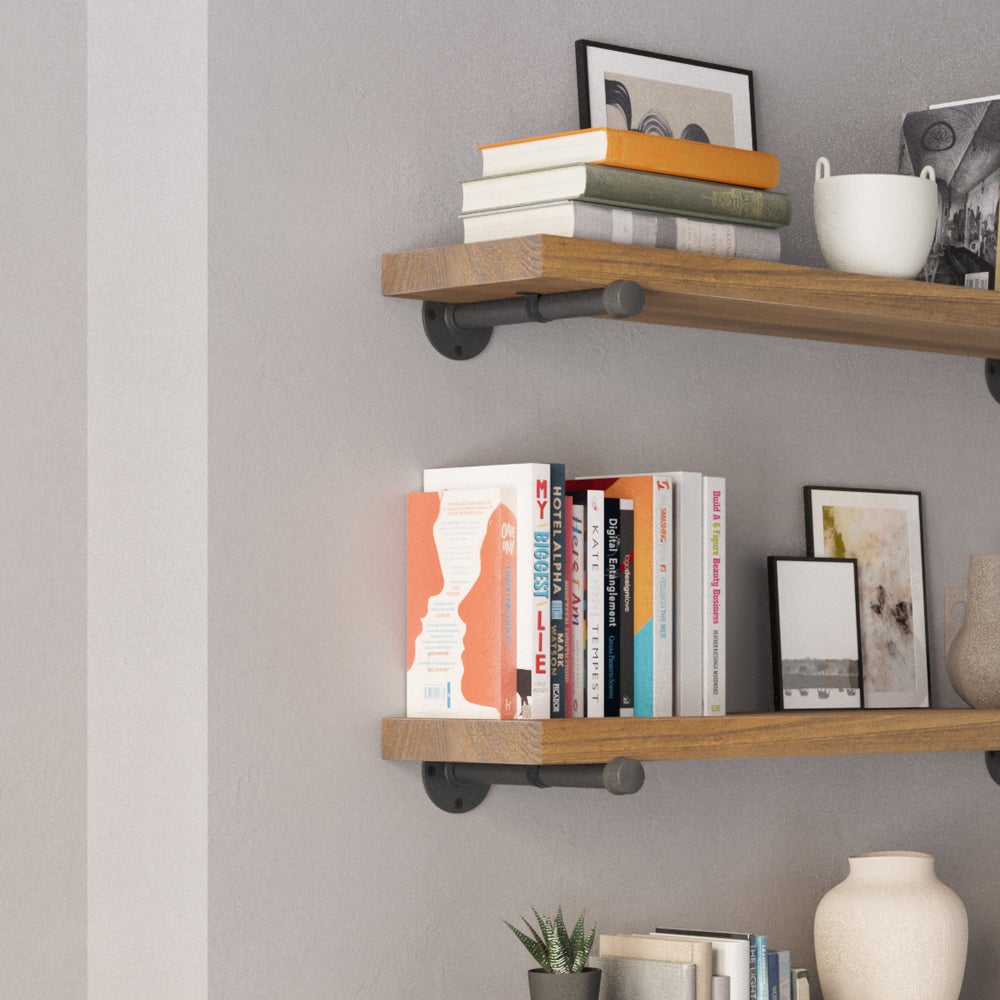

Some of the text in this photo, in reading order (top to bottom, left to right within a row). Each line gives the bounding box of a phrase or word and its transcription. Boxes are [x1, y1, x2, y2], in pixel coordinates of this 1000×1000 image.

[712, 490, 720, 512] Build
[552, 486, 562, 595] HOTEL ALPHA
[711, 530, 720, 556] Figure
[533, 479, 549, 674] MY BIGGEST LIE
[607, 518, 617, 627] Digital Entanglement
[622, 554, 631, 612] logodesignlove
[711, 558, 720, 587] Beauty
[572, 593, 581, 626] Am
[712, 589, 720, 624] Business
